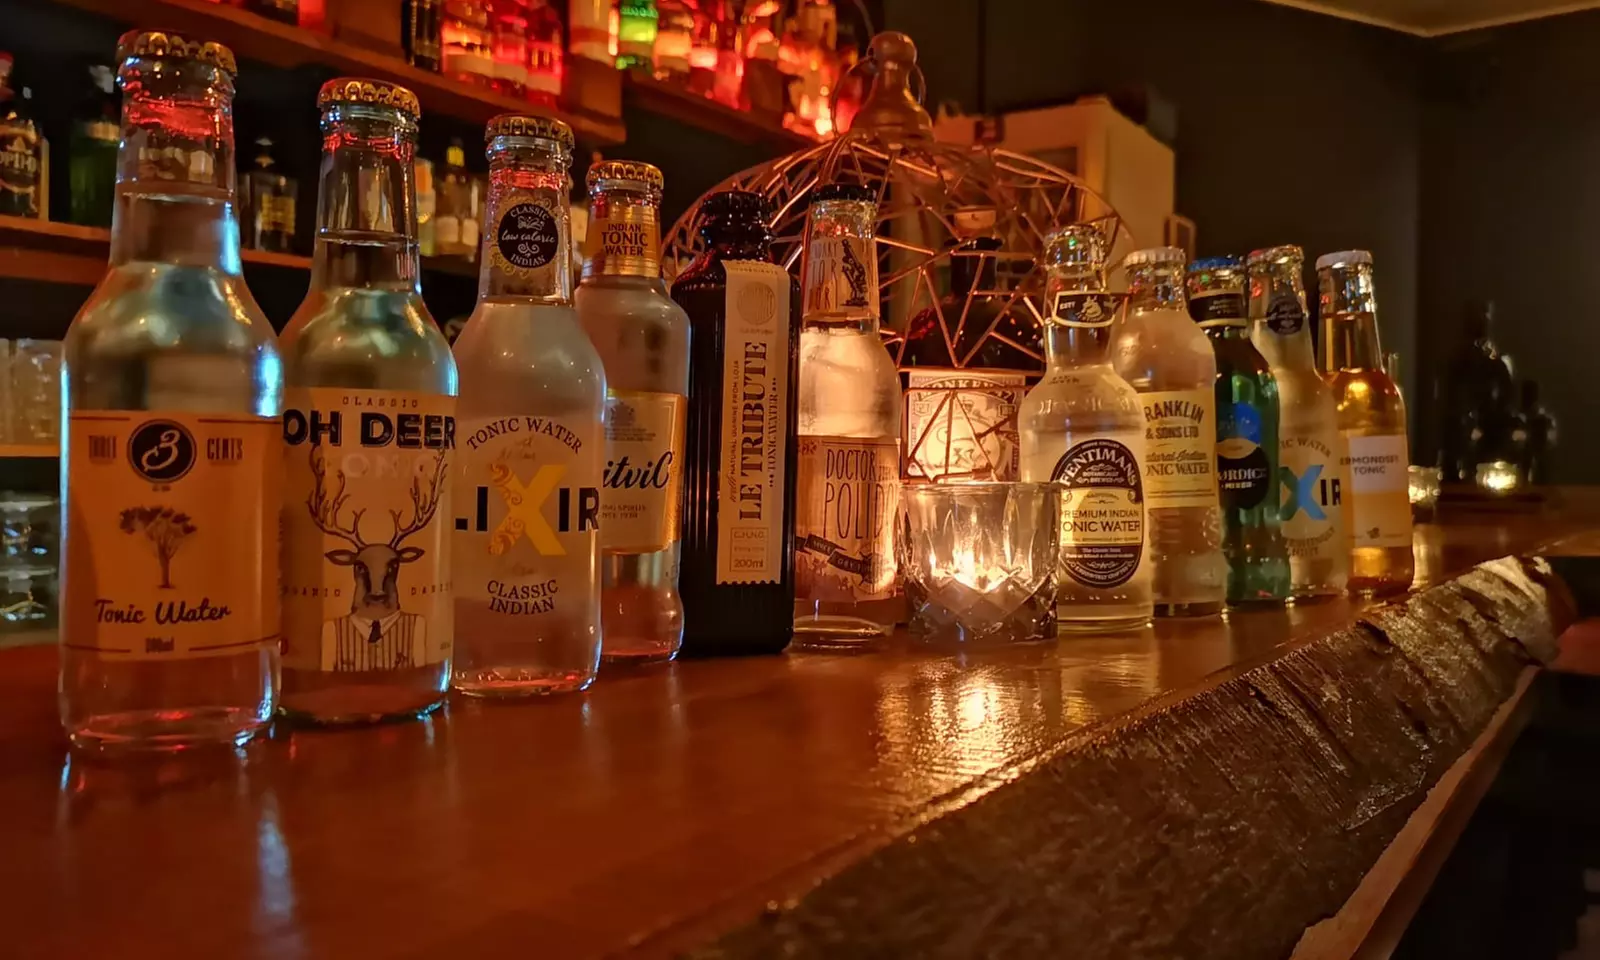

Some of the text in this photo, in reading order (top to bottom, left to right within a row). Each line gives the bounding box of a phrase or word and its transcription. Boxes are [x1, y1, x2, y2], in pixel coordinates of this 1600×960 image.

[510, 206, 549, 220] CLASSIC
[501, 229, 556, 243] low calorie
[607, 223, 642, 233] INDIAN
[601, 231, 648, 247] TONIC
[510, 253, 546, 266] INDIAN
[604, 245, 644, 257] WATER
[740, 342, 767, 477] TRIBUTE
[1143, 400, 1205, 424] RANKLIN
[282, 409, 342, 447] OH
[360, 413, 456, 450] DEER
[466, 417, 520, 450] TONIC
[525, 417, 583, 454] WATER
[767, 394, 779, 471] TONIC WATER
[1145, 428, 1154, 440] &
[729, 439, 737, 475] NATURAL
[825, 448, 877, 481] DOCTOR
[1059, 448, 1138, 488] FENTIMANS
[1353, 465, 1386, 476] TONIC
[739, 483, 763, 521] LE
[1109, 509, 1139, 518] INDIAN
[1062, 520, 1140, 532] ONIC WATER
[733, 558, 763, 568] 200ml
[486, 579, 559, 600] CLASSIC
[94, 597, 232, 625] Tonic Water
[488, 596, 556, 615] INDIAN
